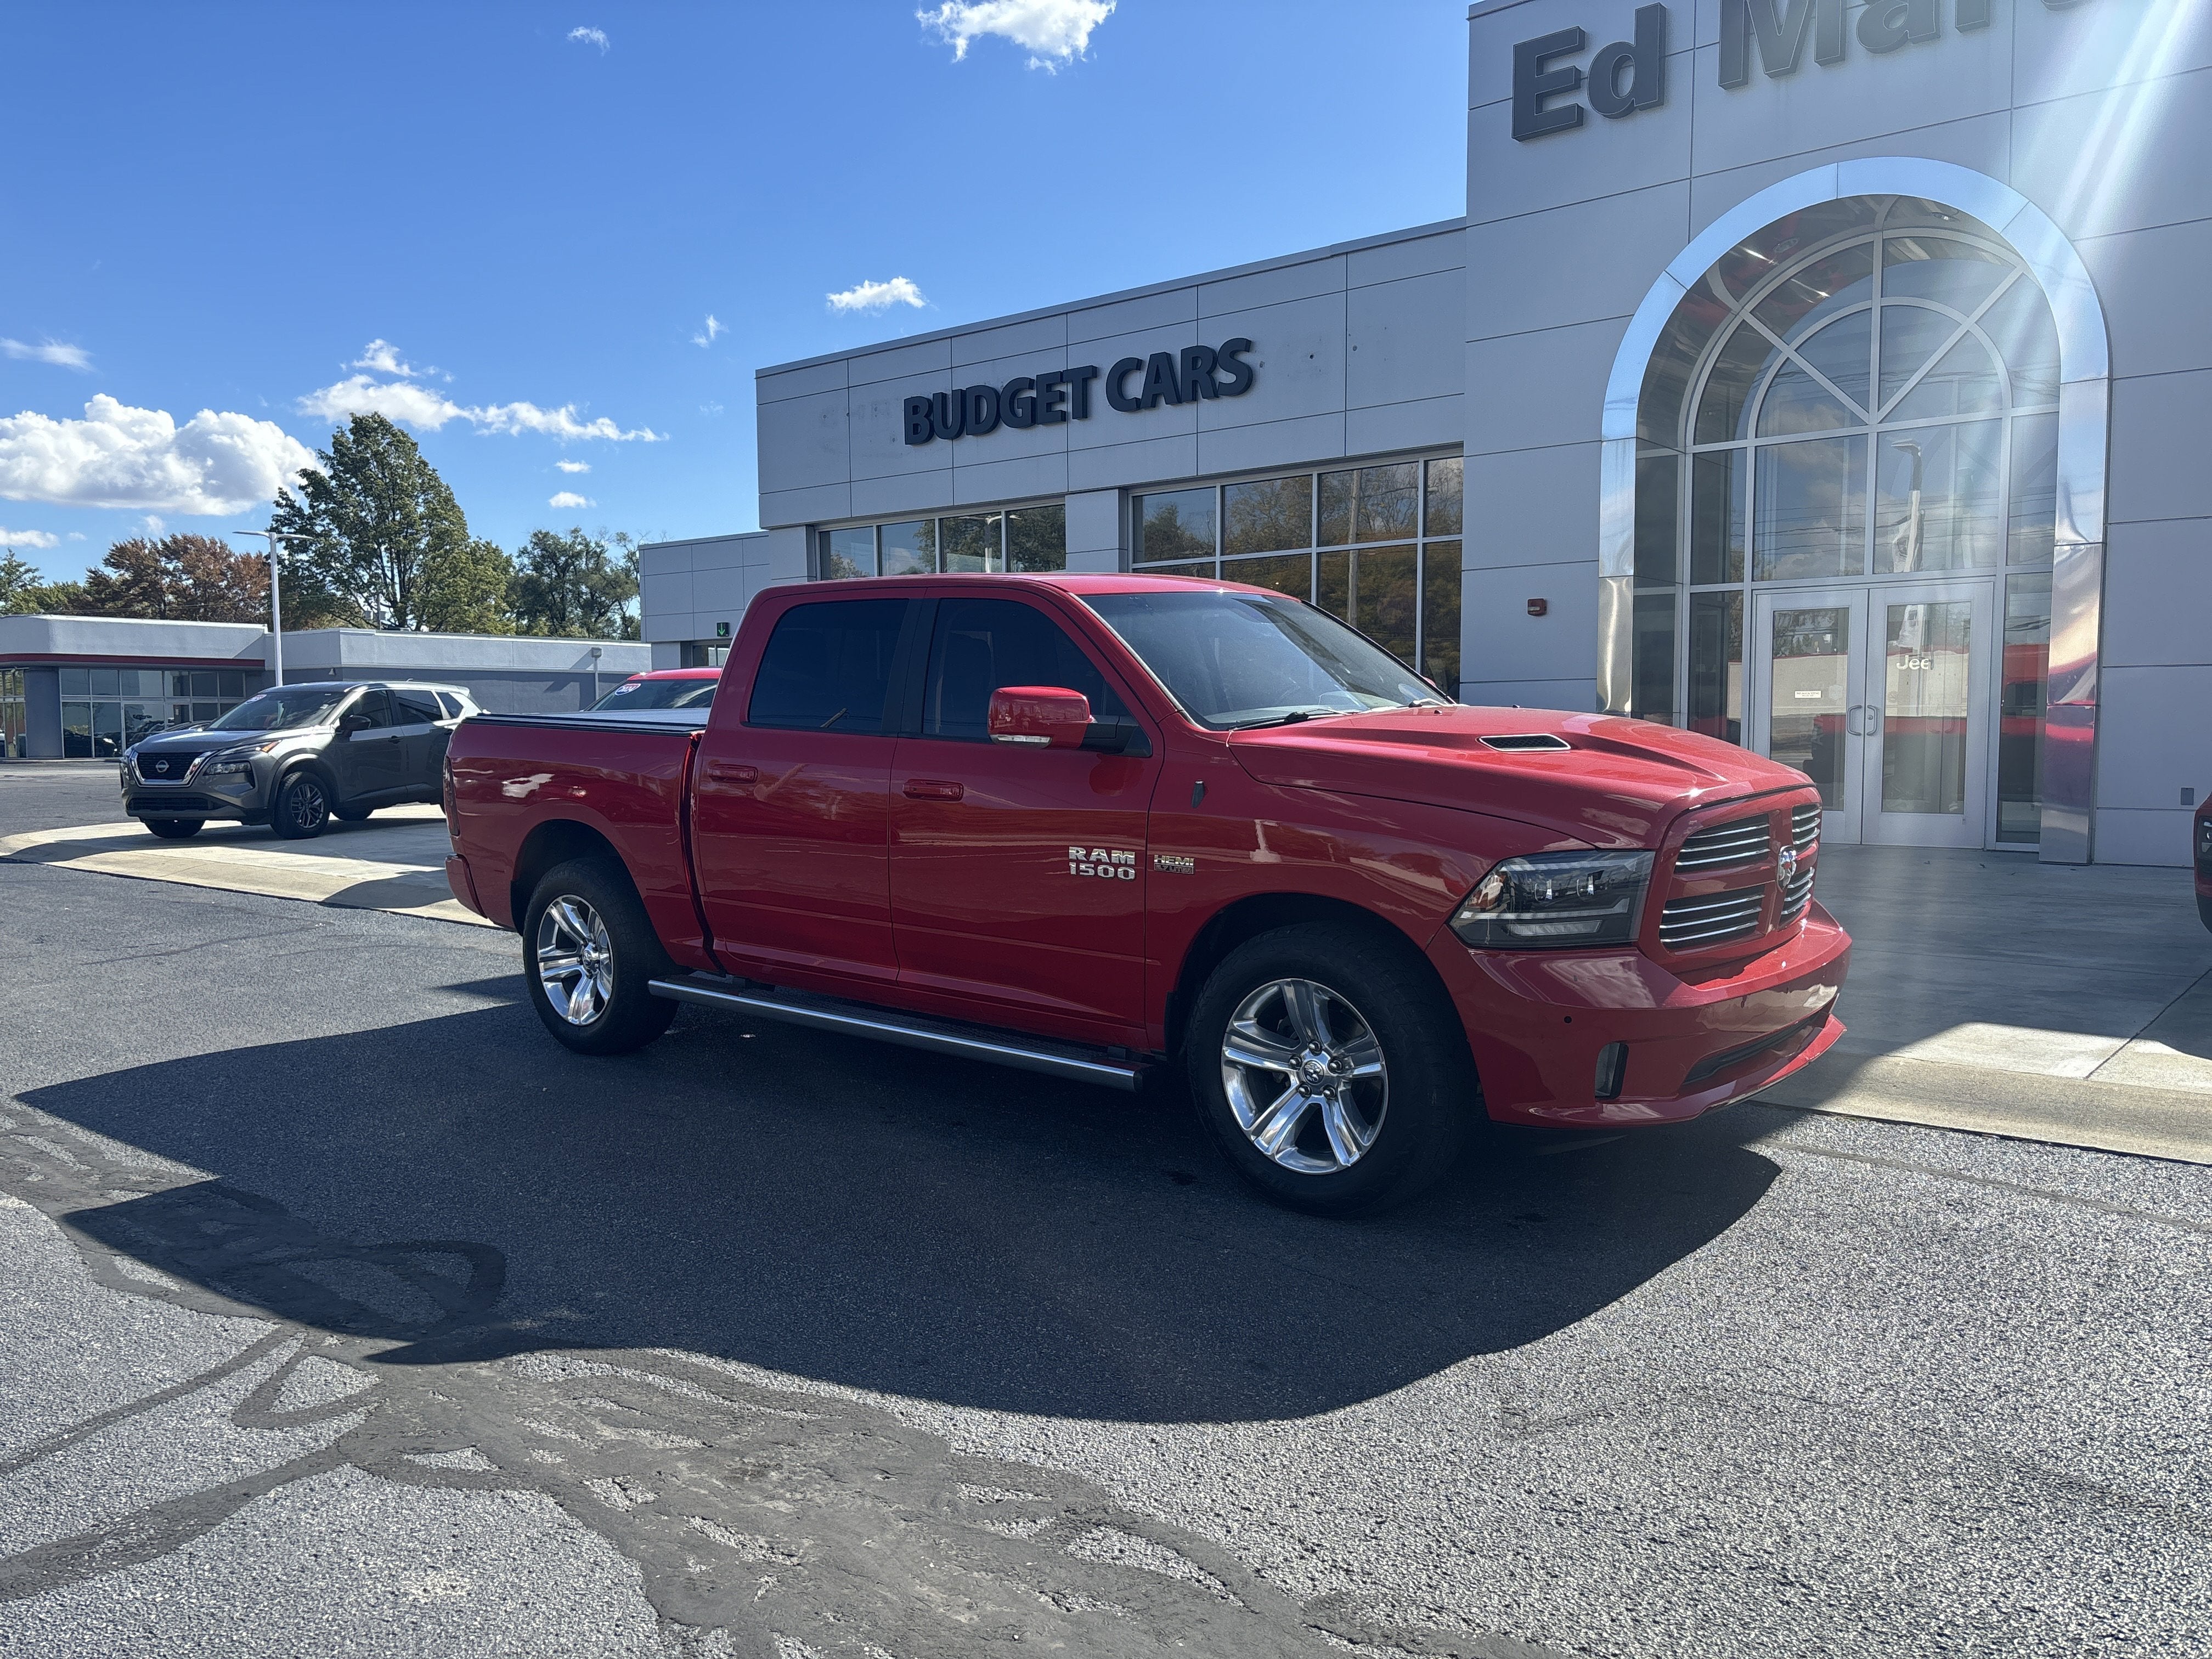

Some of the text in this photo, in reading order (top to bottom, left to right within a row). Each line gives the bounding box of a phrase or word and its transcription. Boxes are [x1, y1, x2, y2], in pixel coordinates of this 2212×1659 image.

[1511, 4, 1667, 142] Ed
[904, 338, 1254, 445] BUDGET CARS
[1896, 655, 1929, 670] Jee
[1069, 846, 1136, 865] RAM
[1154, 854, 1195, 866] HEMI
[1069, 862, 1136, 880] 1500
